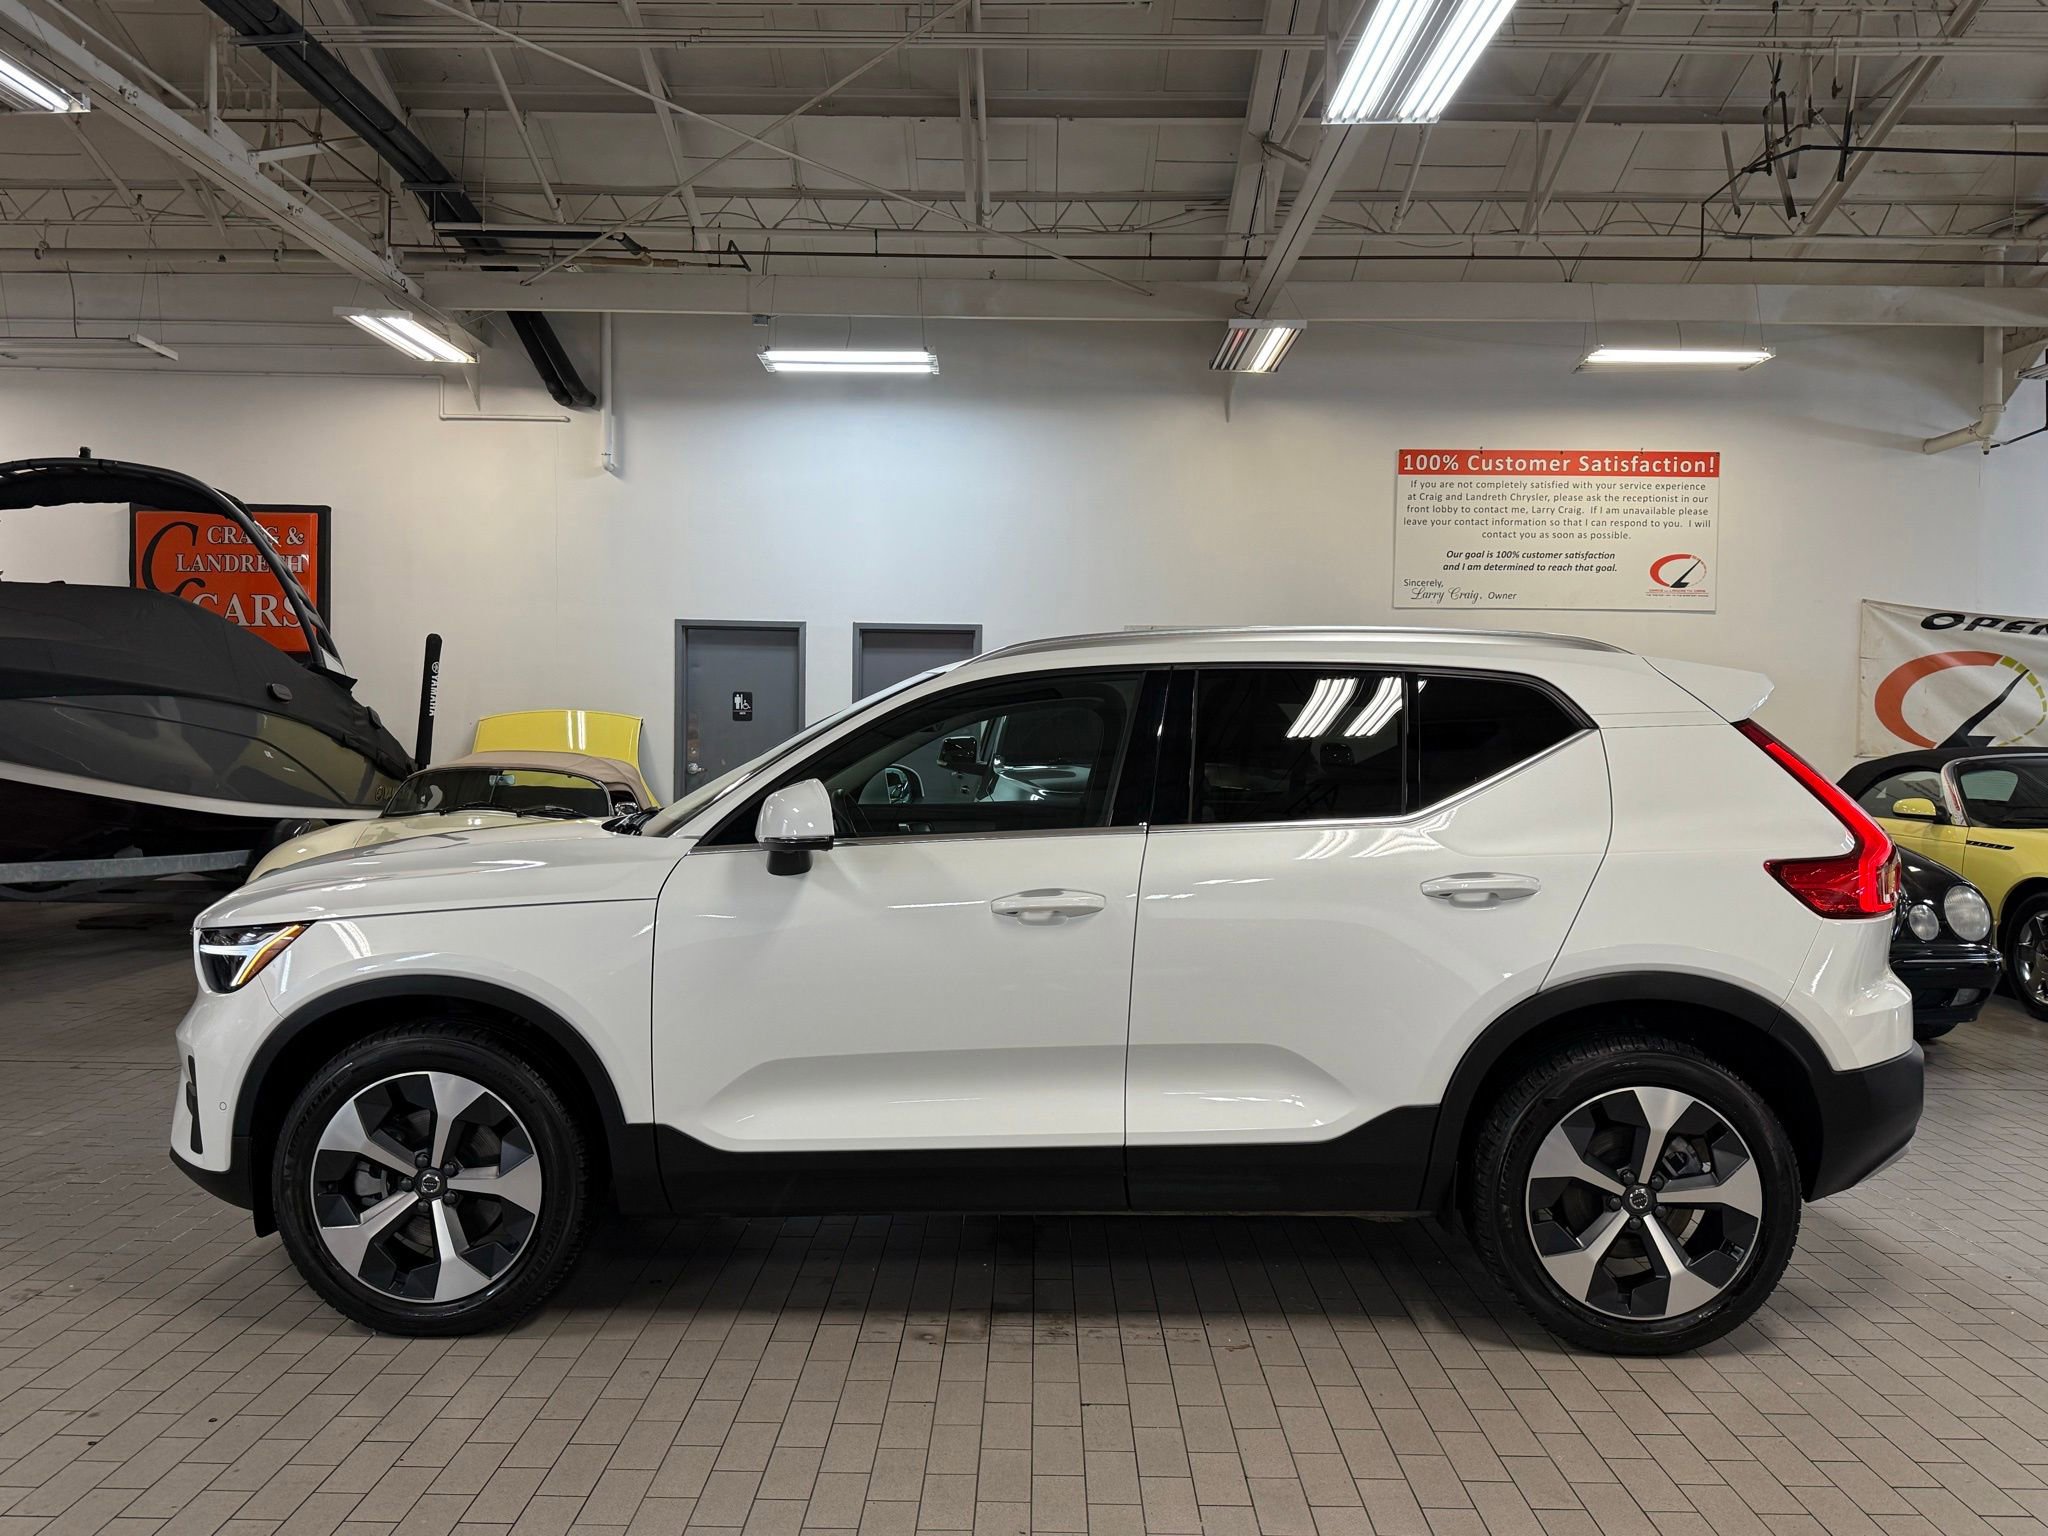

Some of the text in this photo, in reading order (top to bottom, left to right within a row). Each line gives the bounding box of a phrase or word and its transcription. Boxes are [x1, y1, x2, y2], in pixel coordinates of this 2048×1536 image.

[1404, 454, 1714, 473] 100% Customer Satisfaction!
[1420, 482, 1437, 490] you
[1476, 481, 1527, 490] completely
[1530, 481, 1569, 489] satisfied
[1655, 482, 1706, 491] experience
[1419, 493, 1442, 502] Craig
[1510, 493, 1550, 502] Chrysler,
[1554, 494, 1583, 503] please
[1622, 494, 1678, 504] receptionist
[1407, 505, 1429, 513] front
[1432, 505, 1458, 514] lobby
[1532, 506, 1555, 515] Larry
[1558, 506, 1584, 515] Craig.
[1623, 506, 1676, 515] unavailable
[1678, 507, 1708, 516] please
[1404, 517, 1427, 525] leave
[1430, 519, 1451, 527] your
[1492, 518, 1547, 526] information
[1563, 518, 1582, 527] that
[1610, 519, 1647, 528] respond
[207, 526, 280, 544] CRAG
[1590, 532, 1631, 541] possible.
[1464, 551, 1485, 560] goal
[1564, 551, 1615, 560] satisfaction
[176, 554, 304, 573] LANDREH
[1548, 563, 1573, 572] reach
[1595, 564, 1617, 573] goal.
[1403, 579, 1444, 588] Sincerely,
[1411, 587, 1445, 604] Larry
[1488, 591, 1517, 600] Owner
[429, 674, 439, 716] YAMAHA
